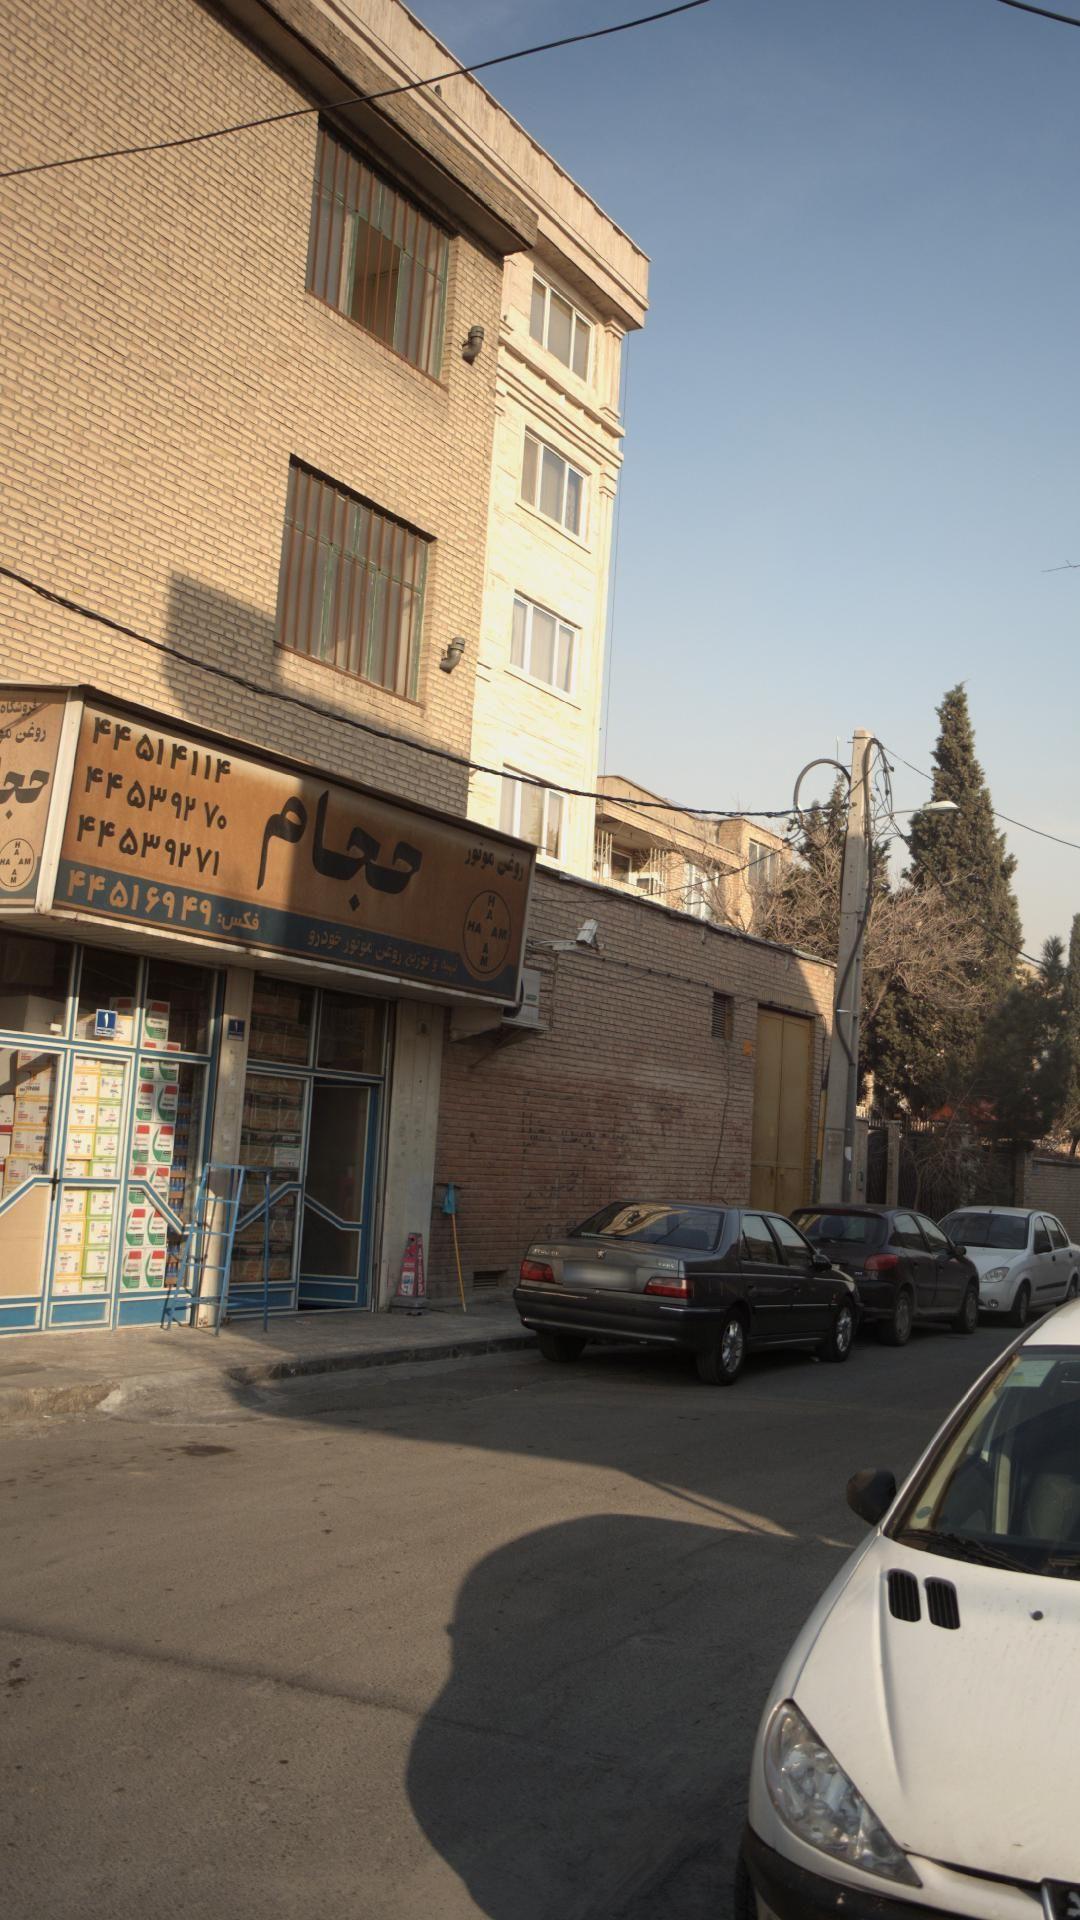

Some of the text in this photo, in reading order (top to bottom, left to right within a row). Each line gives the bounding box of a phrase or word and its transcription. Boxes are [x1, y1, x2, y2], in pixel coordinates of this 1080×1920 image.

[15, 722, 47, 743] روغن
[92, 716, 232, 783] ۴۴۵۱۴۱۱۴
[76, 814, 221, 877] ۴۴۵۳۹۲۷۱
[256, 789, 423, 912] حجام
[464, 841, 524, 882] روغن موتور
[67, 869, 213, 926] ۴۴۵۱۶۹۴۹
[306, 929, 342, 950] خودرو
